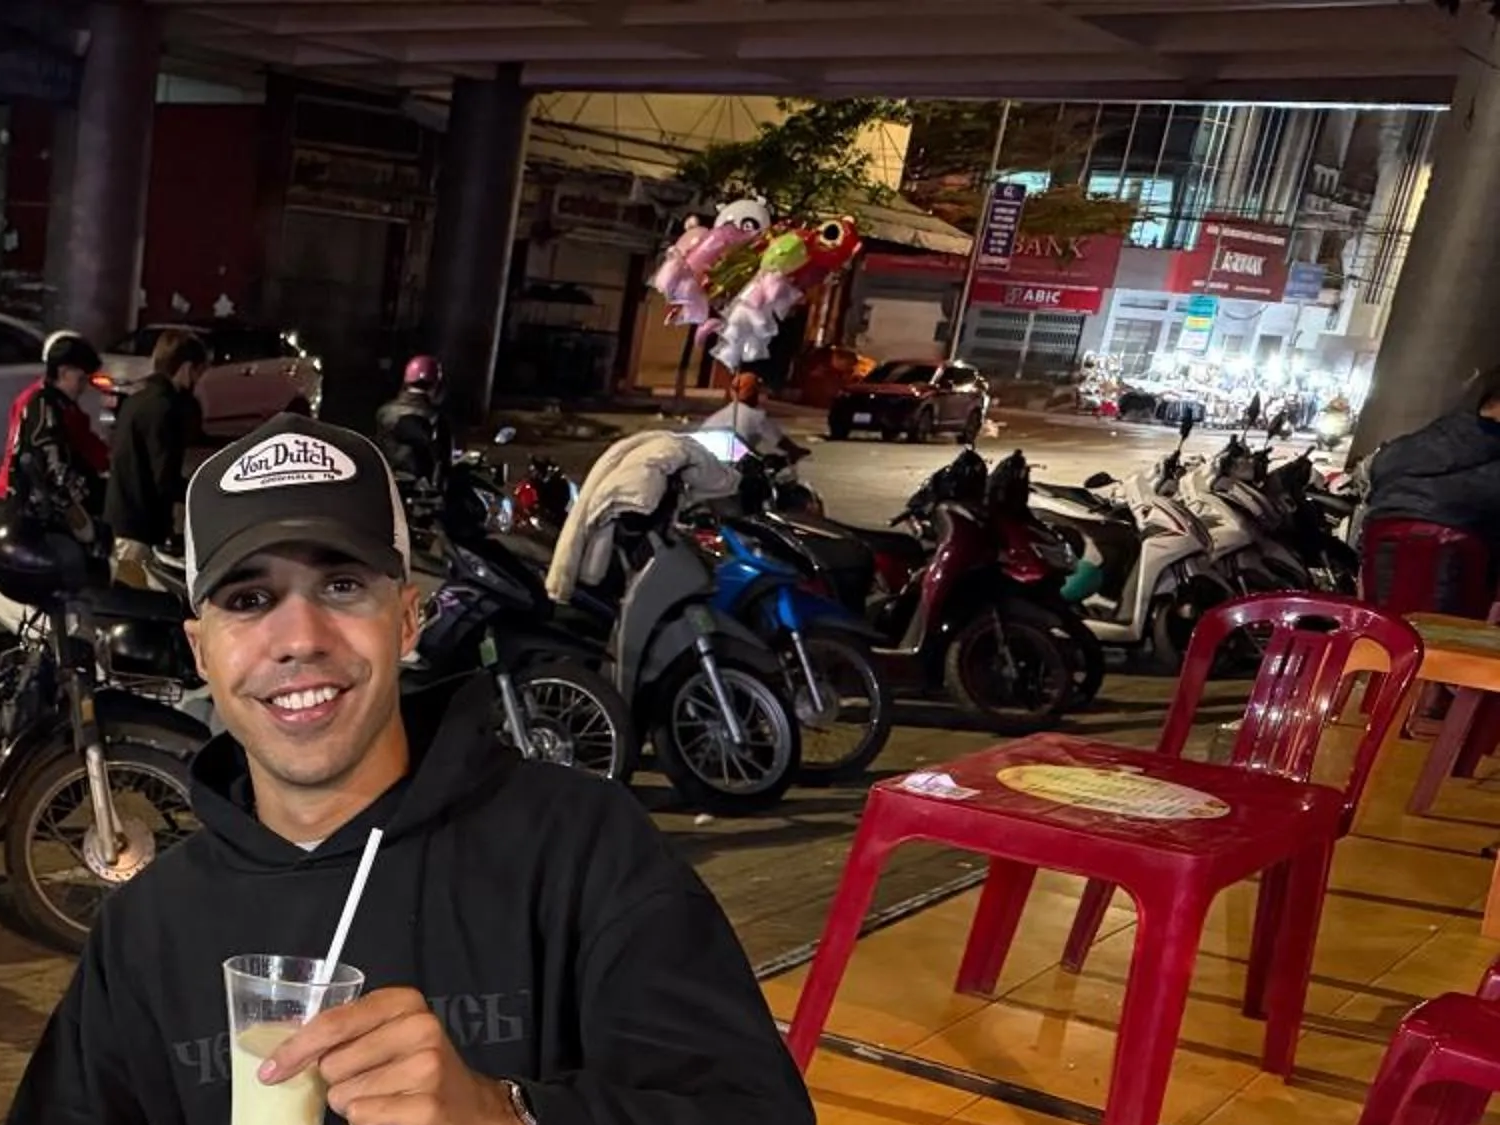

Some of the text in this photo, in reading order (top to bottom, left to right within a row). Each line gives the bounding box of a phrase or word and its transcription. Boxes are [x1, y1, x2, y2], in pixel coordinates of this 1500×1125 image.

[1023, 289, 1061, 304] ABIC
[237, 439, 338, 476] Von Dutch
